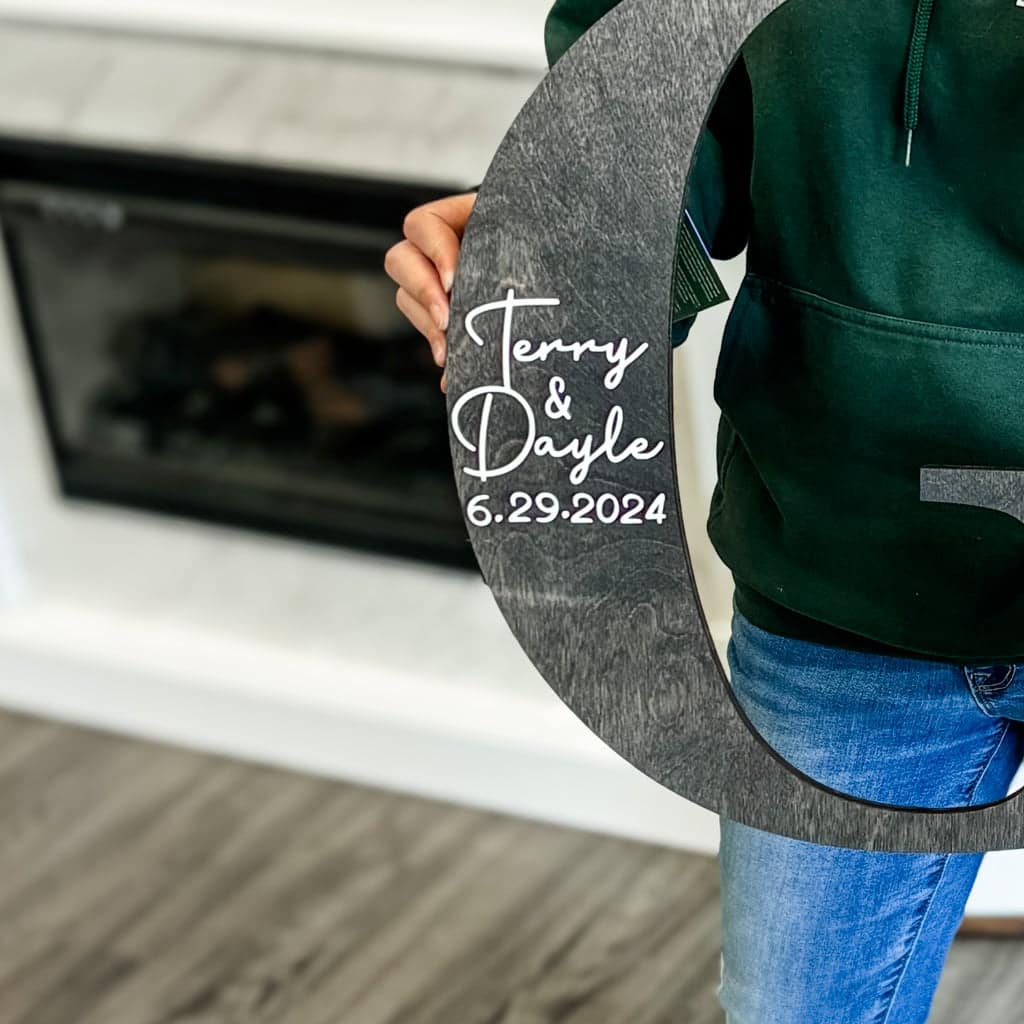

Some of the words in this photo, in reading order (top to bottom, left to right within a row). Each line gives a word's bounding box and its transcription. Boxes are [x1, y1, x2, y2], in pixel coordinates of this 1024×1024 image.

[464, 289, 649, 390] Terry
[544, 376, 572, 420] &
[451, 385, 665, 485] Dayle
[466, 491, 667, 527] 6.29.2024
